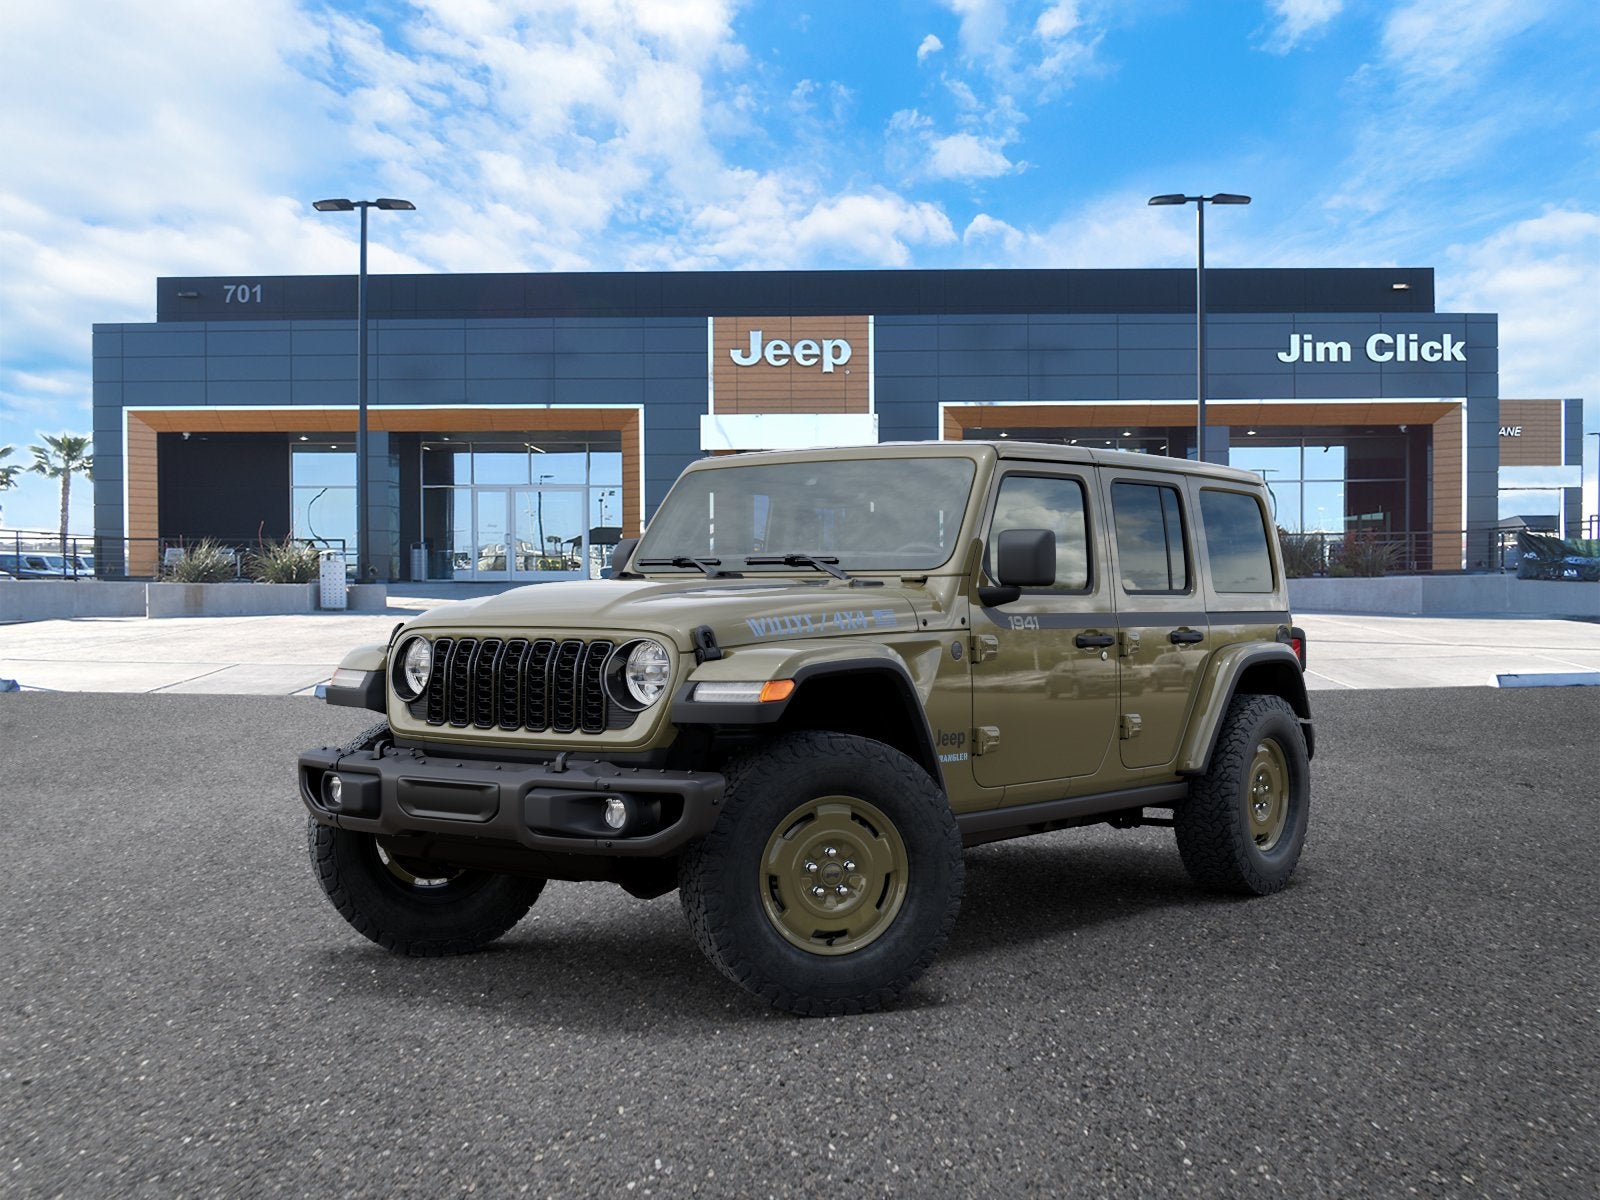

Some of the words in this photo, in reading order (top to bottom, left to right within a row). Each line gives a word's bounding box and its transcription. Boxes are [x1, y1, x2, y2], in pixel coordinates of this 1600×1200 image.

[223, 284, 262, 304] 701
[729, 329, 853, 374] Jeep
[1277, 333, 1352, 363] Jim
[1365, 332, 1468, 363] Click
[745, 613, 815, 638] WILLYS
[1007, 615, 1040, 631] 1941
[936, 728, 966, 749] Jeep
[939, 752, 969, 763] RANGLER
